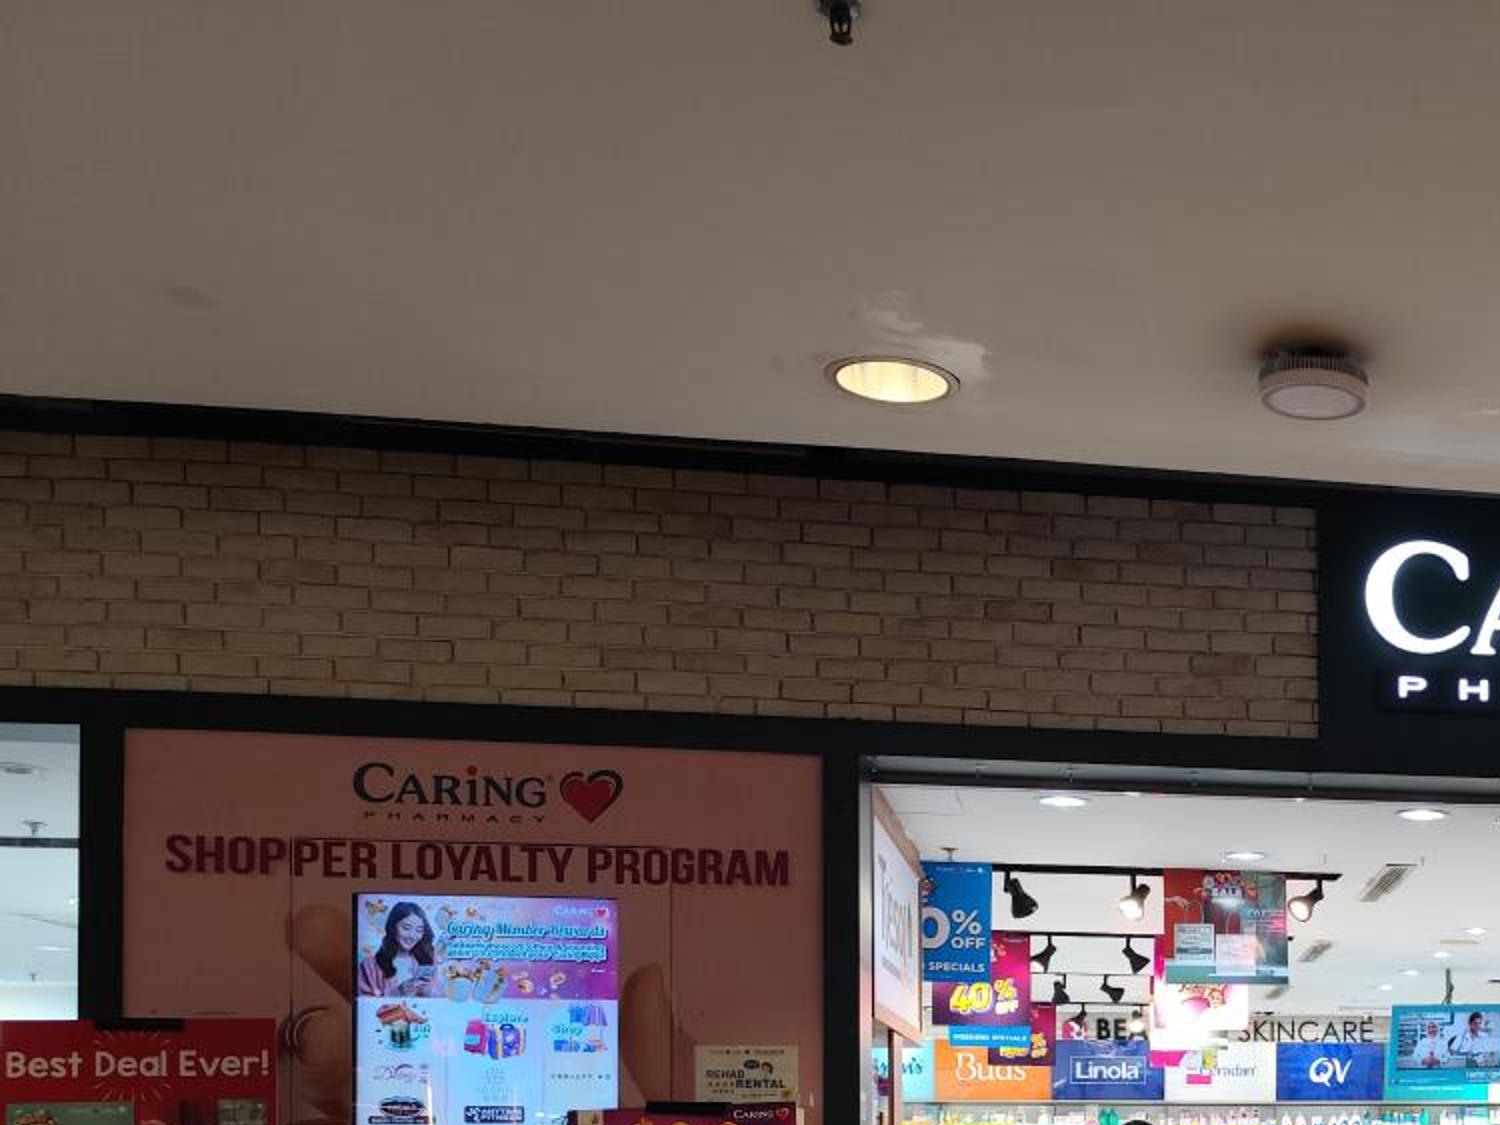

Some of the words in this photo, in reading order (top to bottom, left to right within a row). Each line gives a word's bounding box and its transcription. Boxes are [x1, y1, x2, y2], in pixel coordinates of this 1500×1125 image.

[164, 834, 377, 880] SHOPPER
[391, 841, 574, 883] LOYALTY
[586, 845, 791, 887] PROGRAM
[951, 937, 986, 949] OFF
[928, 961, 986, 973] SPECIALS
[5, 1050, 83, 1079] Best
[94, 1049, 168, 1078] Deal
[178, 1049, 271, 1078] Ever!
[1075, 1061, 1140, 1080] Linola
[1308, 1056, 1354, 1088] QV
[734, 1079, 786, 1089] RENTAL
